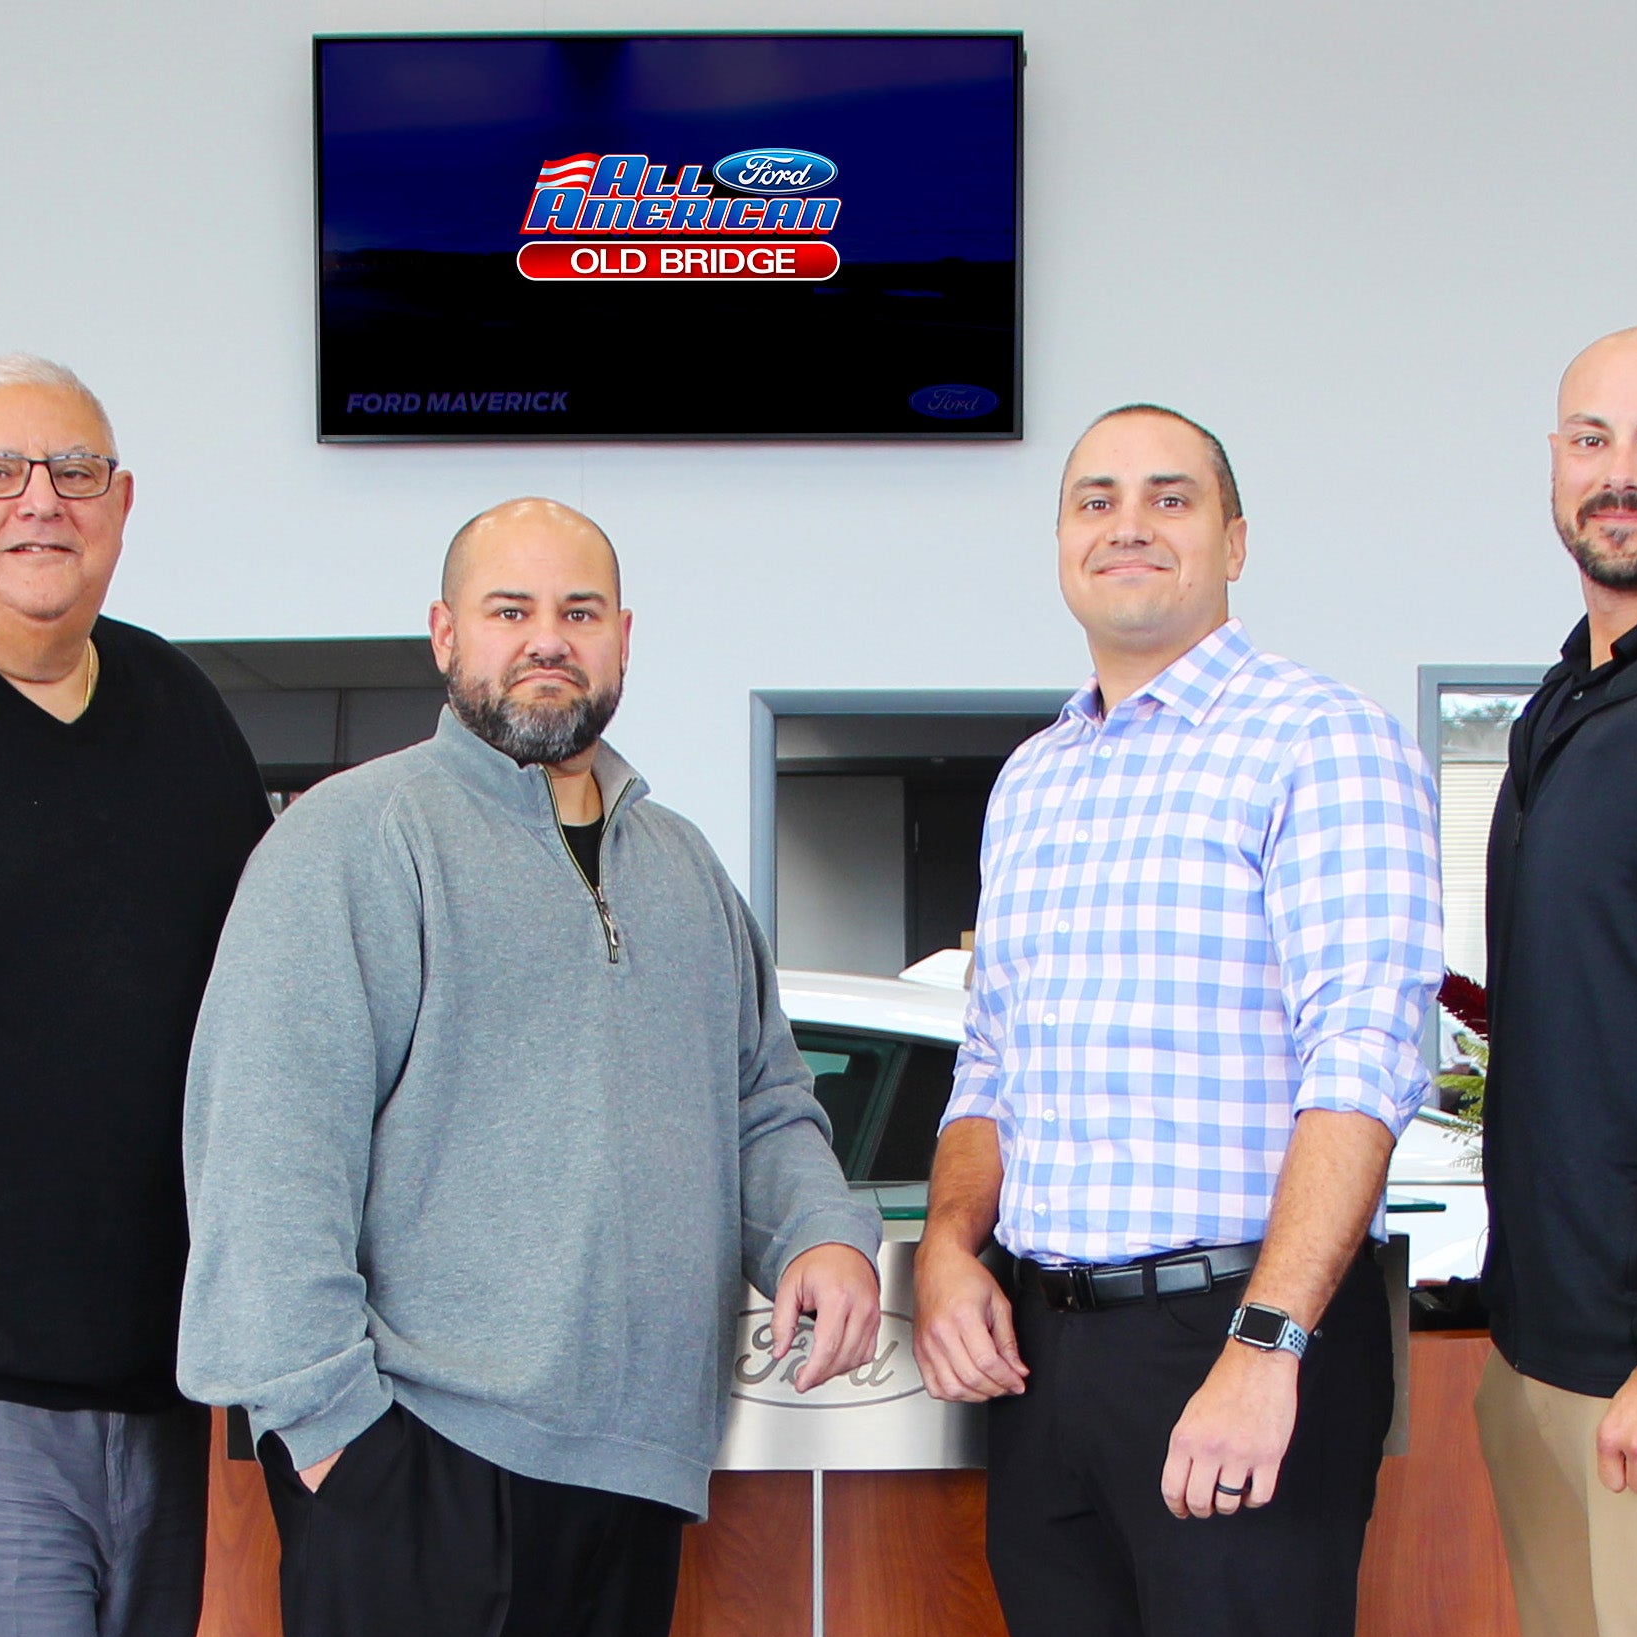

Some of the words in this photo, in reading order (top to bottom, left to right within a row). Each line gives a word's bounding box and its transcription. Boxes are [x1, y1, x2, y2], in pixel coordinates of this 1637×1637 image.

[590, 154, 714, 197] ALL
[738, 156, 813, 187] Ford
[521, 186, 842, 233] AMERICAN
[570, 248, 647, 274] OLD
[660, 248, 796, 274] BRIDGE
[347, 393, 421, 413] FORD
[426, 391, 569, 412] MAVERICK
